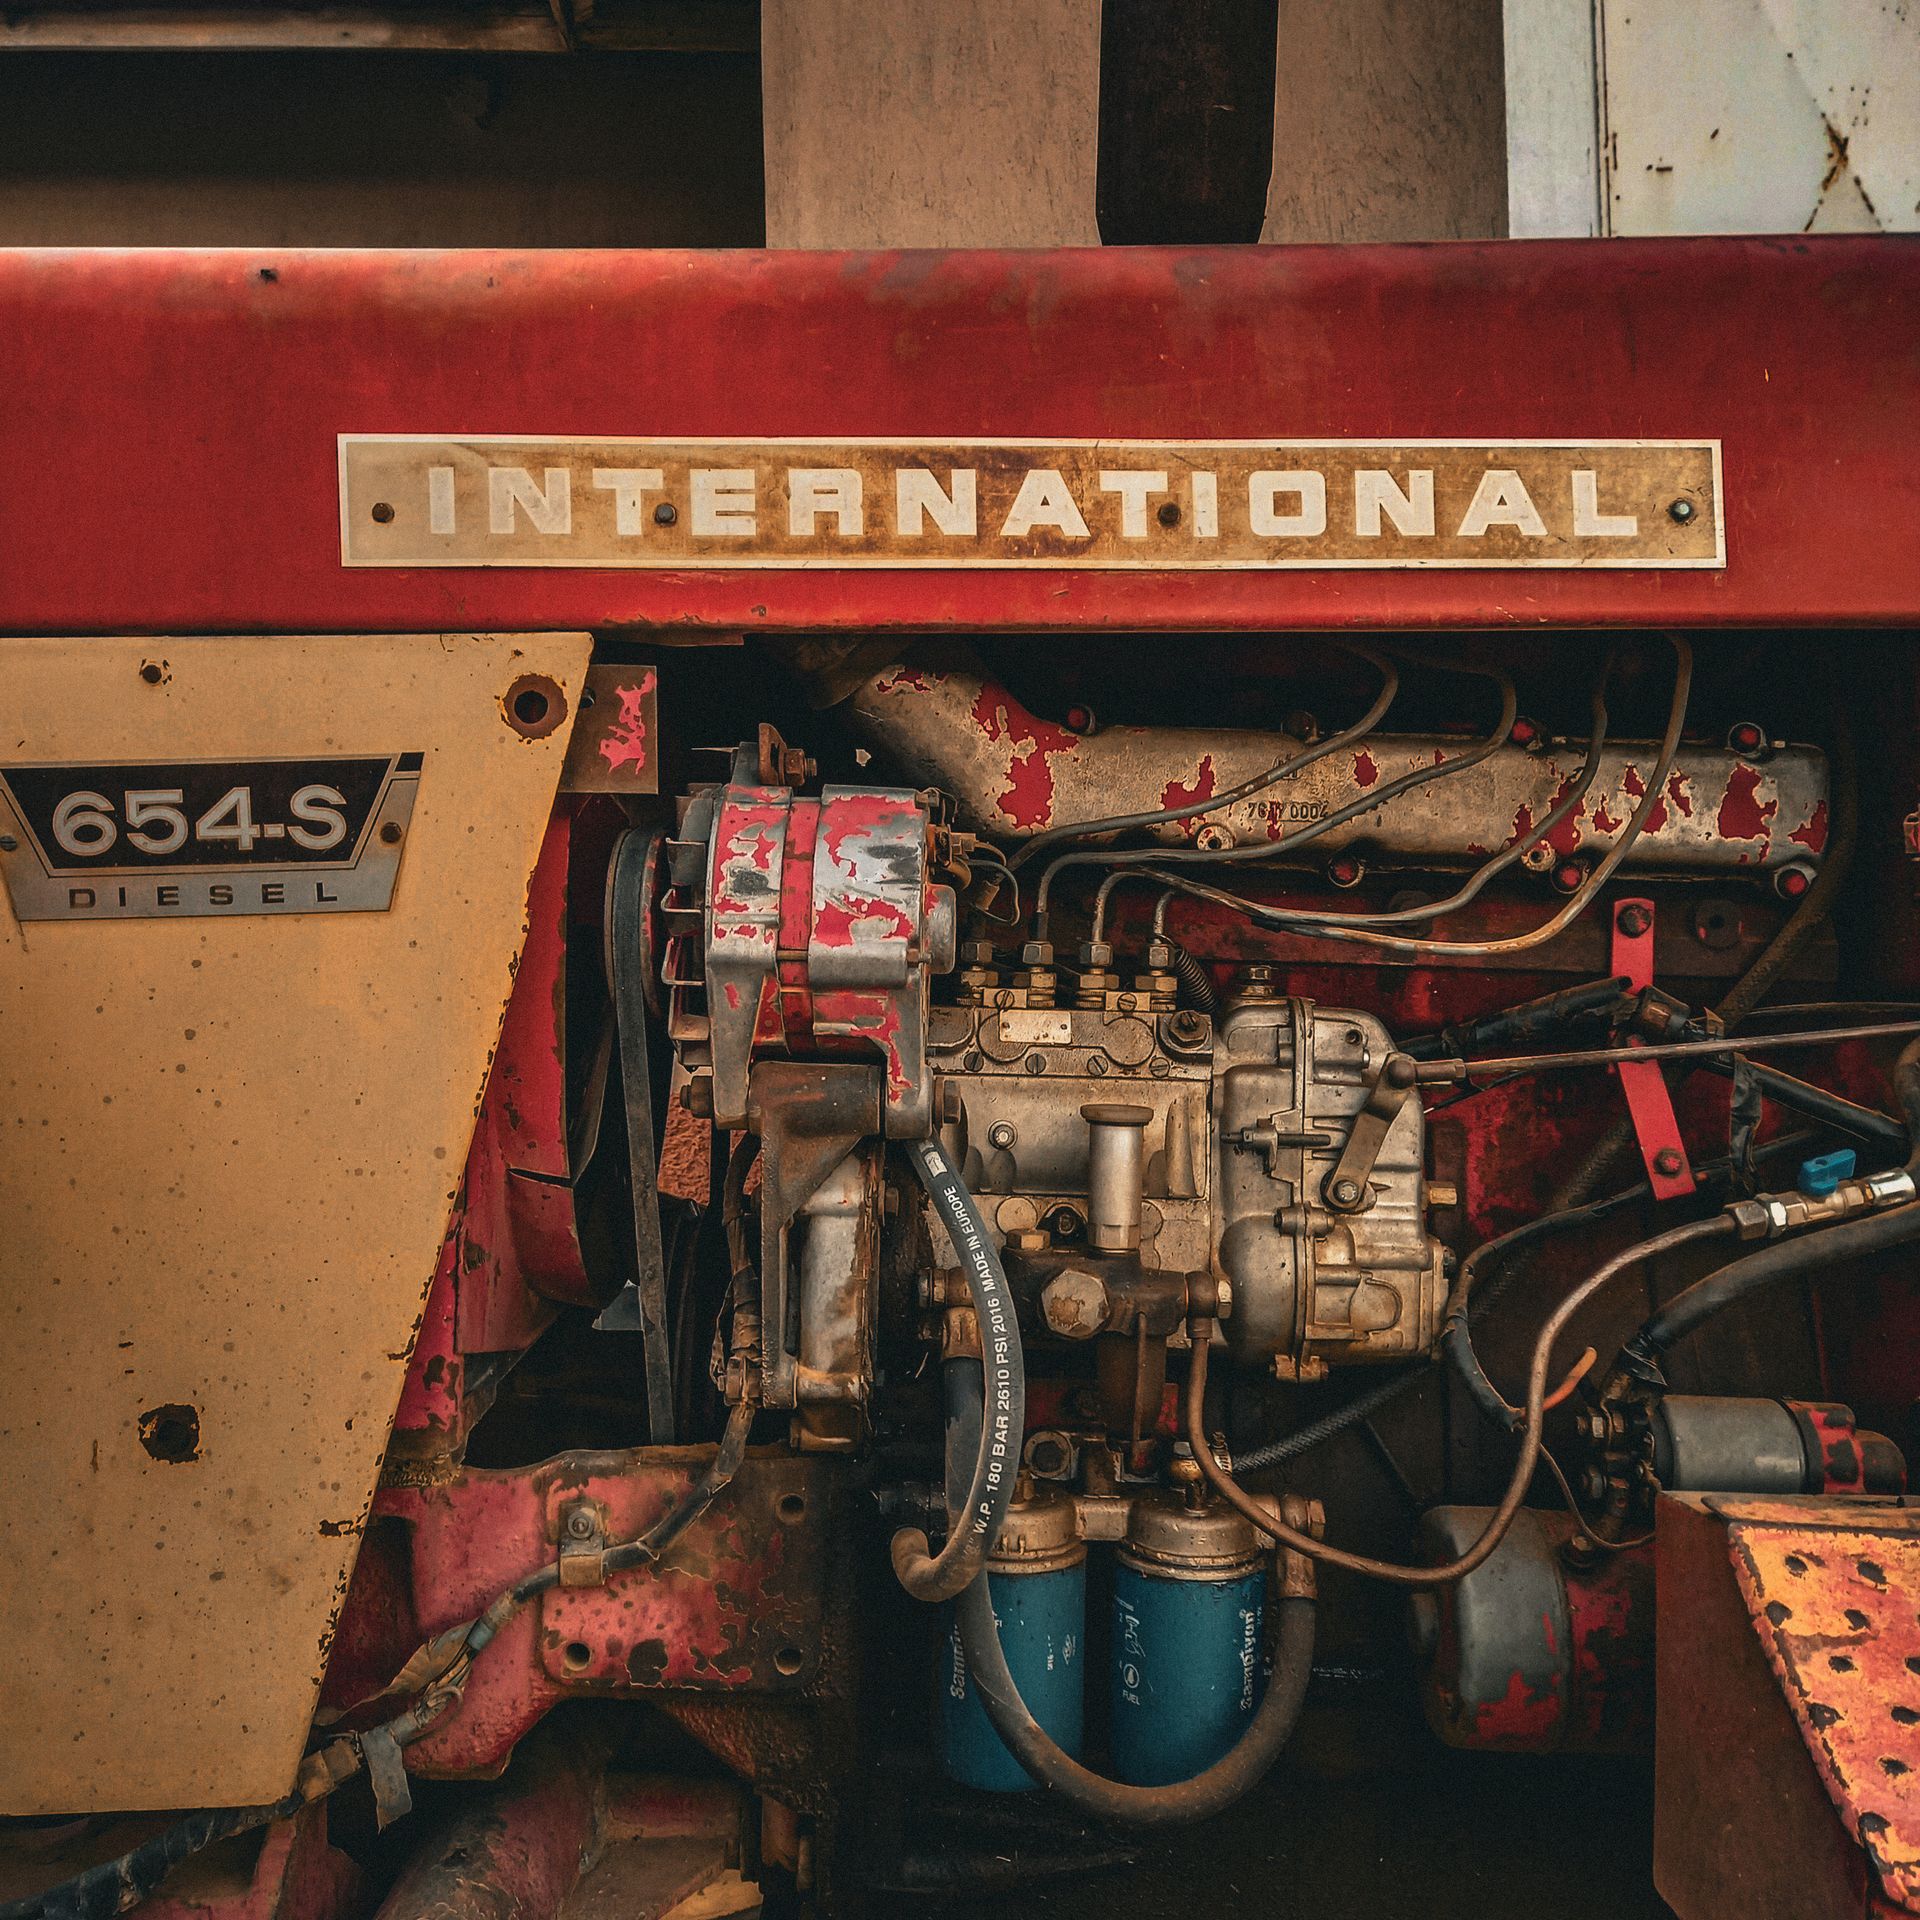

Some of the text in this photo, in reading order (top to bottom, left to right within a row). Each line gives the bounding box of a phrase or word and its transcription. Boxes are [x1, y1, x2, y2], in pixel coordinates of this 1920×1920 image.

[428, 466, 1638, 538] INTERNATIONAL
[52, 783, 347, 857] 654-S
[68, 881, 338, 910] DIESEL
[943, 1185, 975, 1235] EUROPE
[966, 1237, 981, 1251] IN
[972, 1251, 996, 1292] MADE
[987, 1298, 1008, 1337] 2016
[994, 1338, 1009, 1365] PSI
[997, 1369, 1010, 1411] 2610
[992, 1416, 1009, 1457] BAR
[986, 1462, 1003, 1492] 180
[973, 1499, 995, 1534] W.P.
[1122, 1690, 1140, 1706] FUEL
